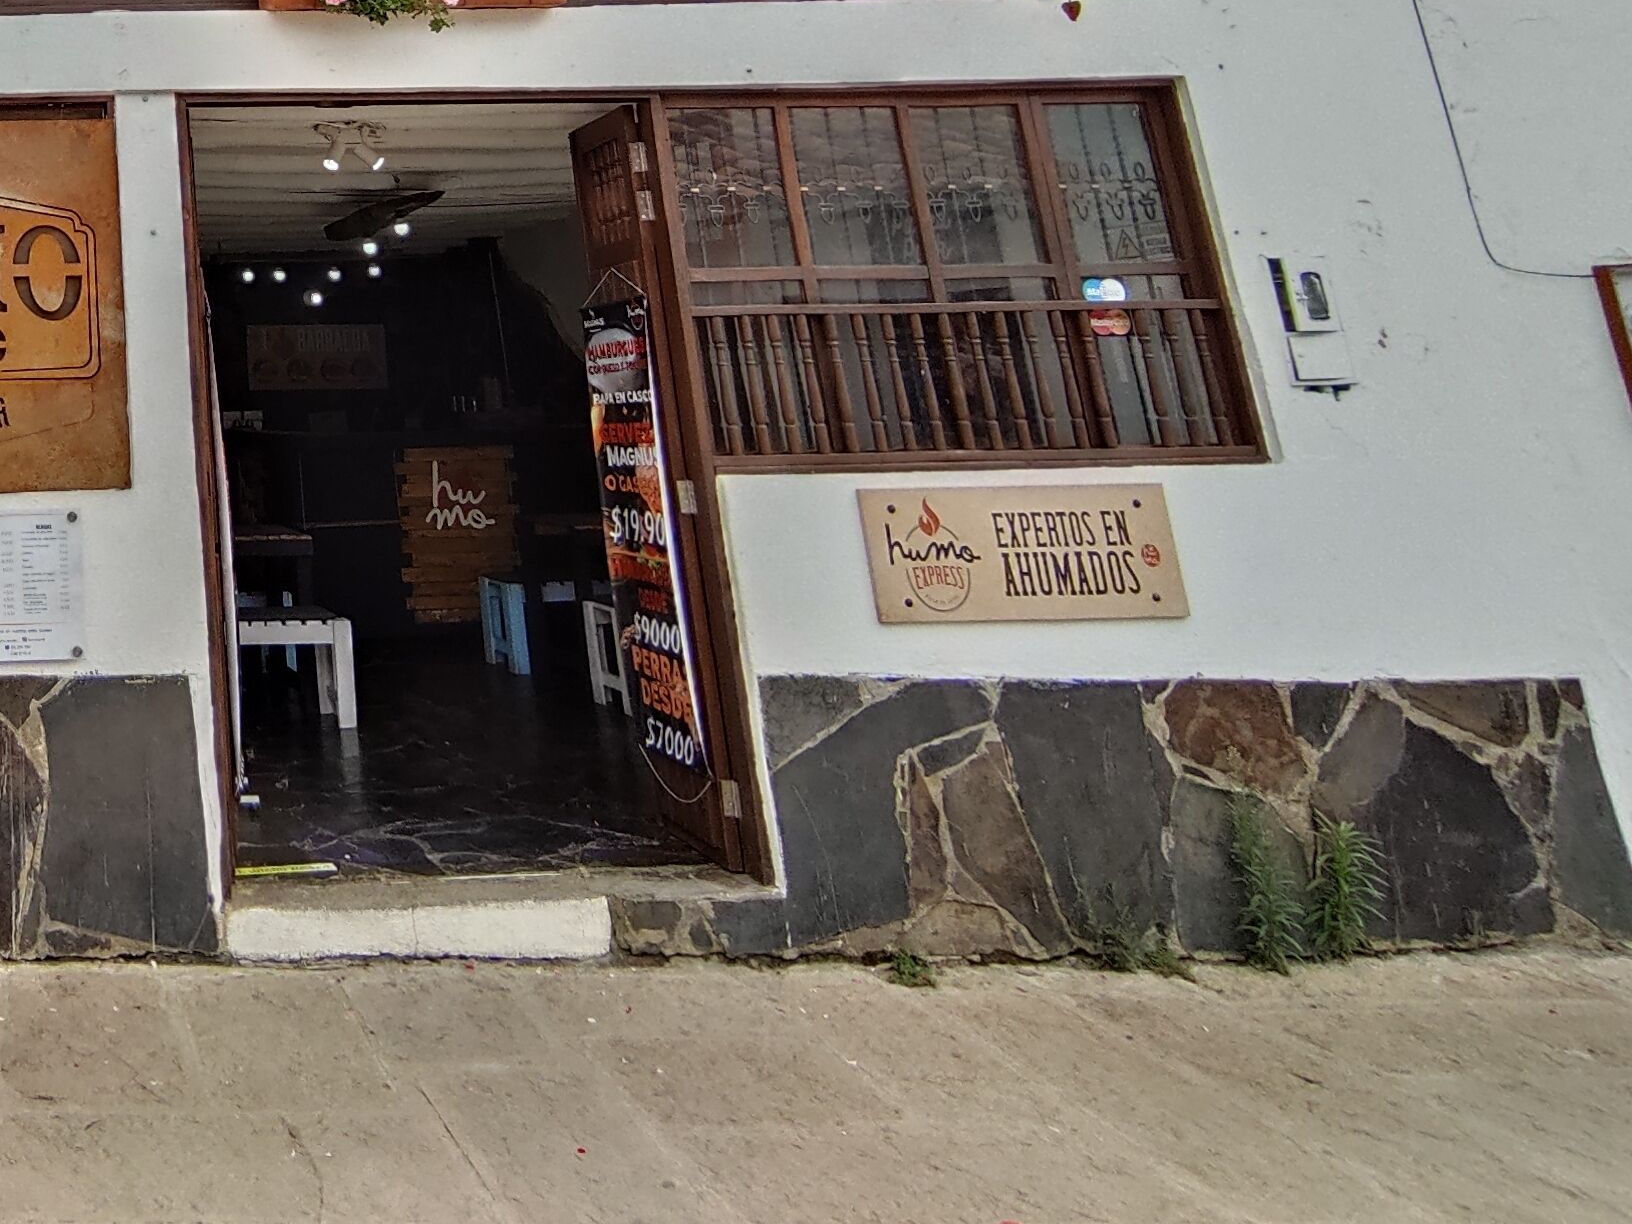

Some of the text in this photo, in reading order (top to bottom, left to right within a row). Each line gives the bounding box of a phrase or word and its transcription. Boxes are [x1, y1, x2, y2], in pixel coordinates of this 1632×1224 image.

[885, 523, 981, 566] humo
[991, 510, 1132, 548] EXPERTOS EN
[912, 565, 965, 589] EXPRESS
[1001, 550, 1141, 596] AHUMADOS
[646, 717, 695, 766] $7000
